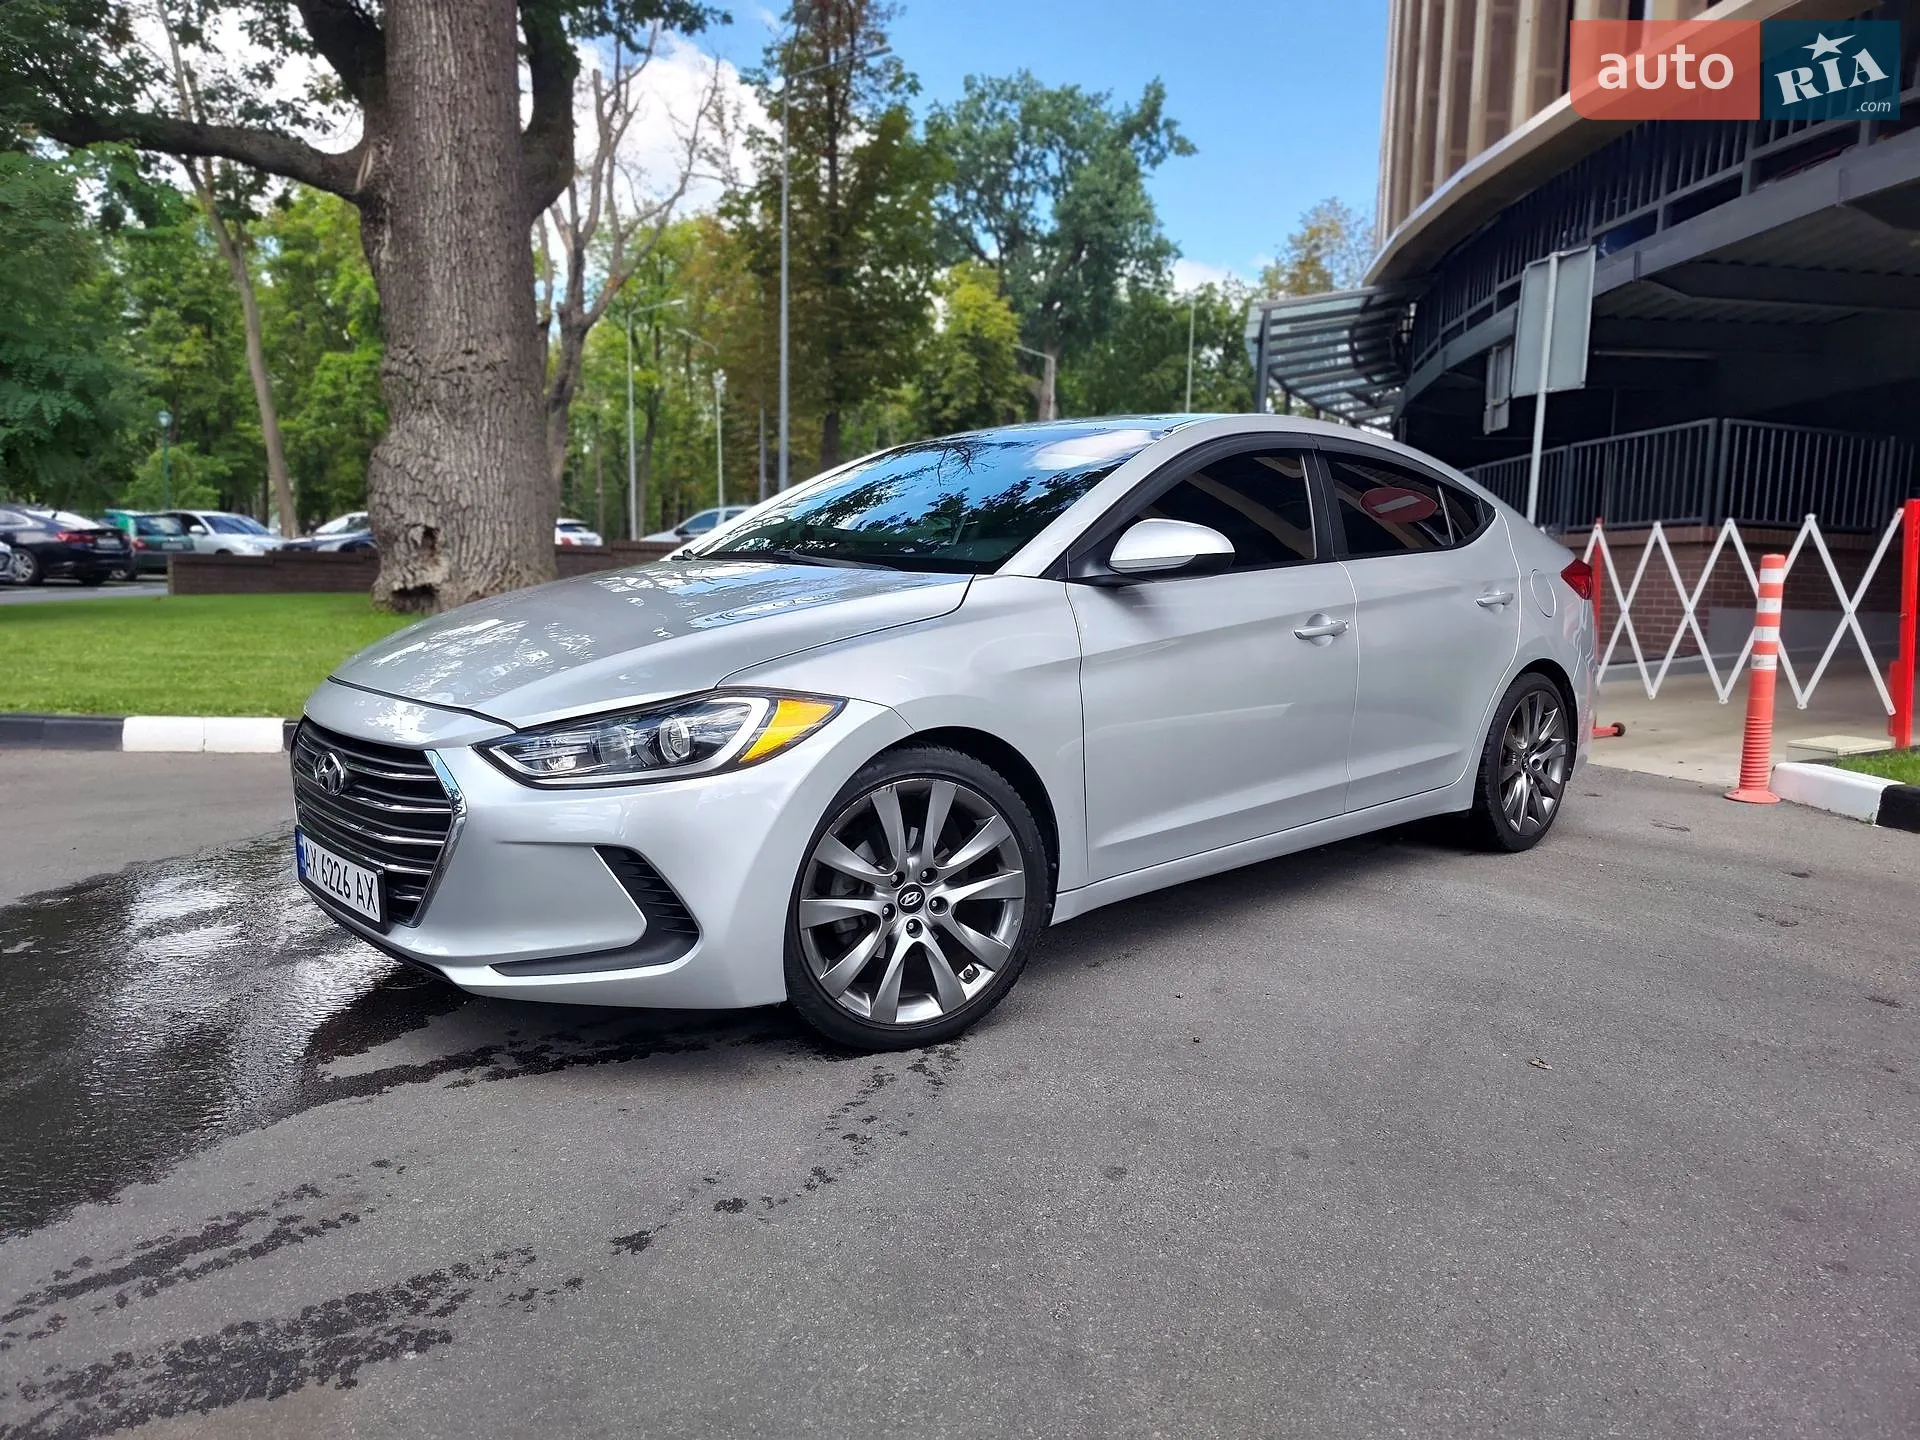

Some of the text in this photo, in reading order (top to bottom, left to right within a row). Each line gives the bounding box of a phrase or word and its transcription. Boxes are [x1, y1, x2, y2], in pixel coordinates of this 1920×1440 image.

[305, 842, 377, 914] AX 6226 AX
